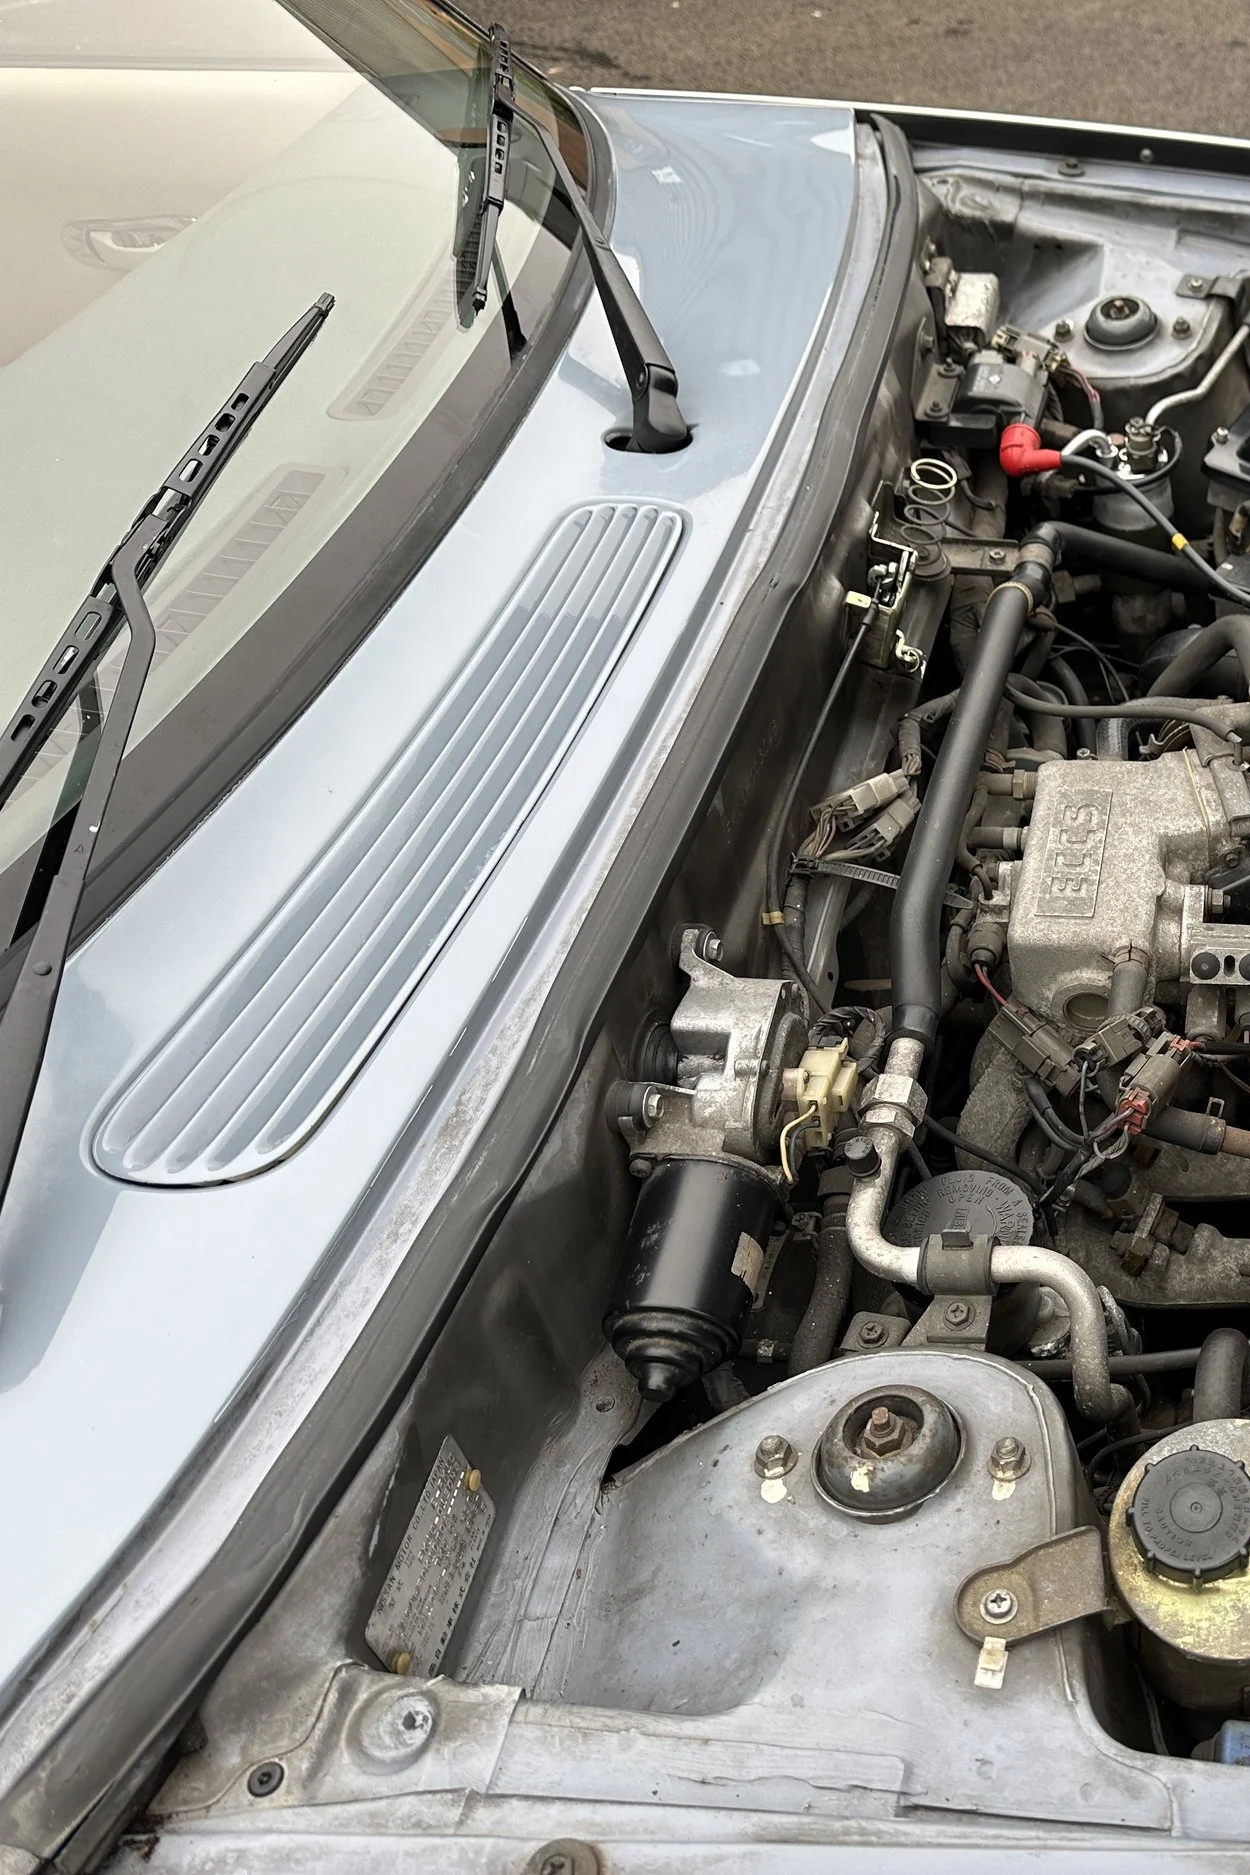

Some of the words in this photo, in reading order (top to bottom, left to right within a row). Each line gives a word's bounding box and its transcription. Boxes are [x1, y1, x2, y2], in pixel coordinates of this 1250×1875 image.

[1050, 804, 1101, 897] ECCS
[941, 1173, 975, 1185] FLUID
[985, 1176, 1014, 1196] FROM
[948, 1195, 985, 1205] OPEN
[377, 1575, 397, 1615] NISSAN
[396, 1536, 413, 1570] MOTOR
[430, 1458, 444, 1488] JAPAN
